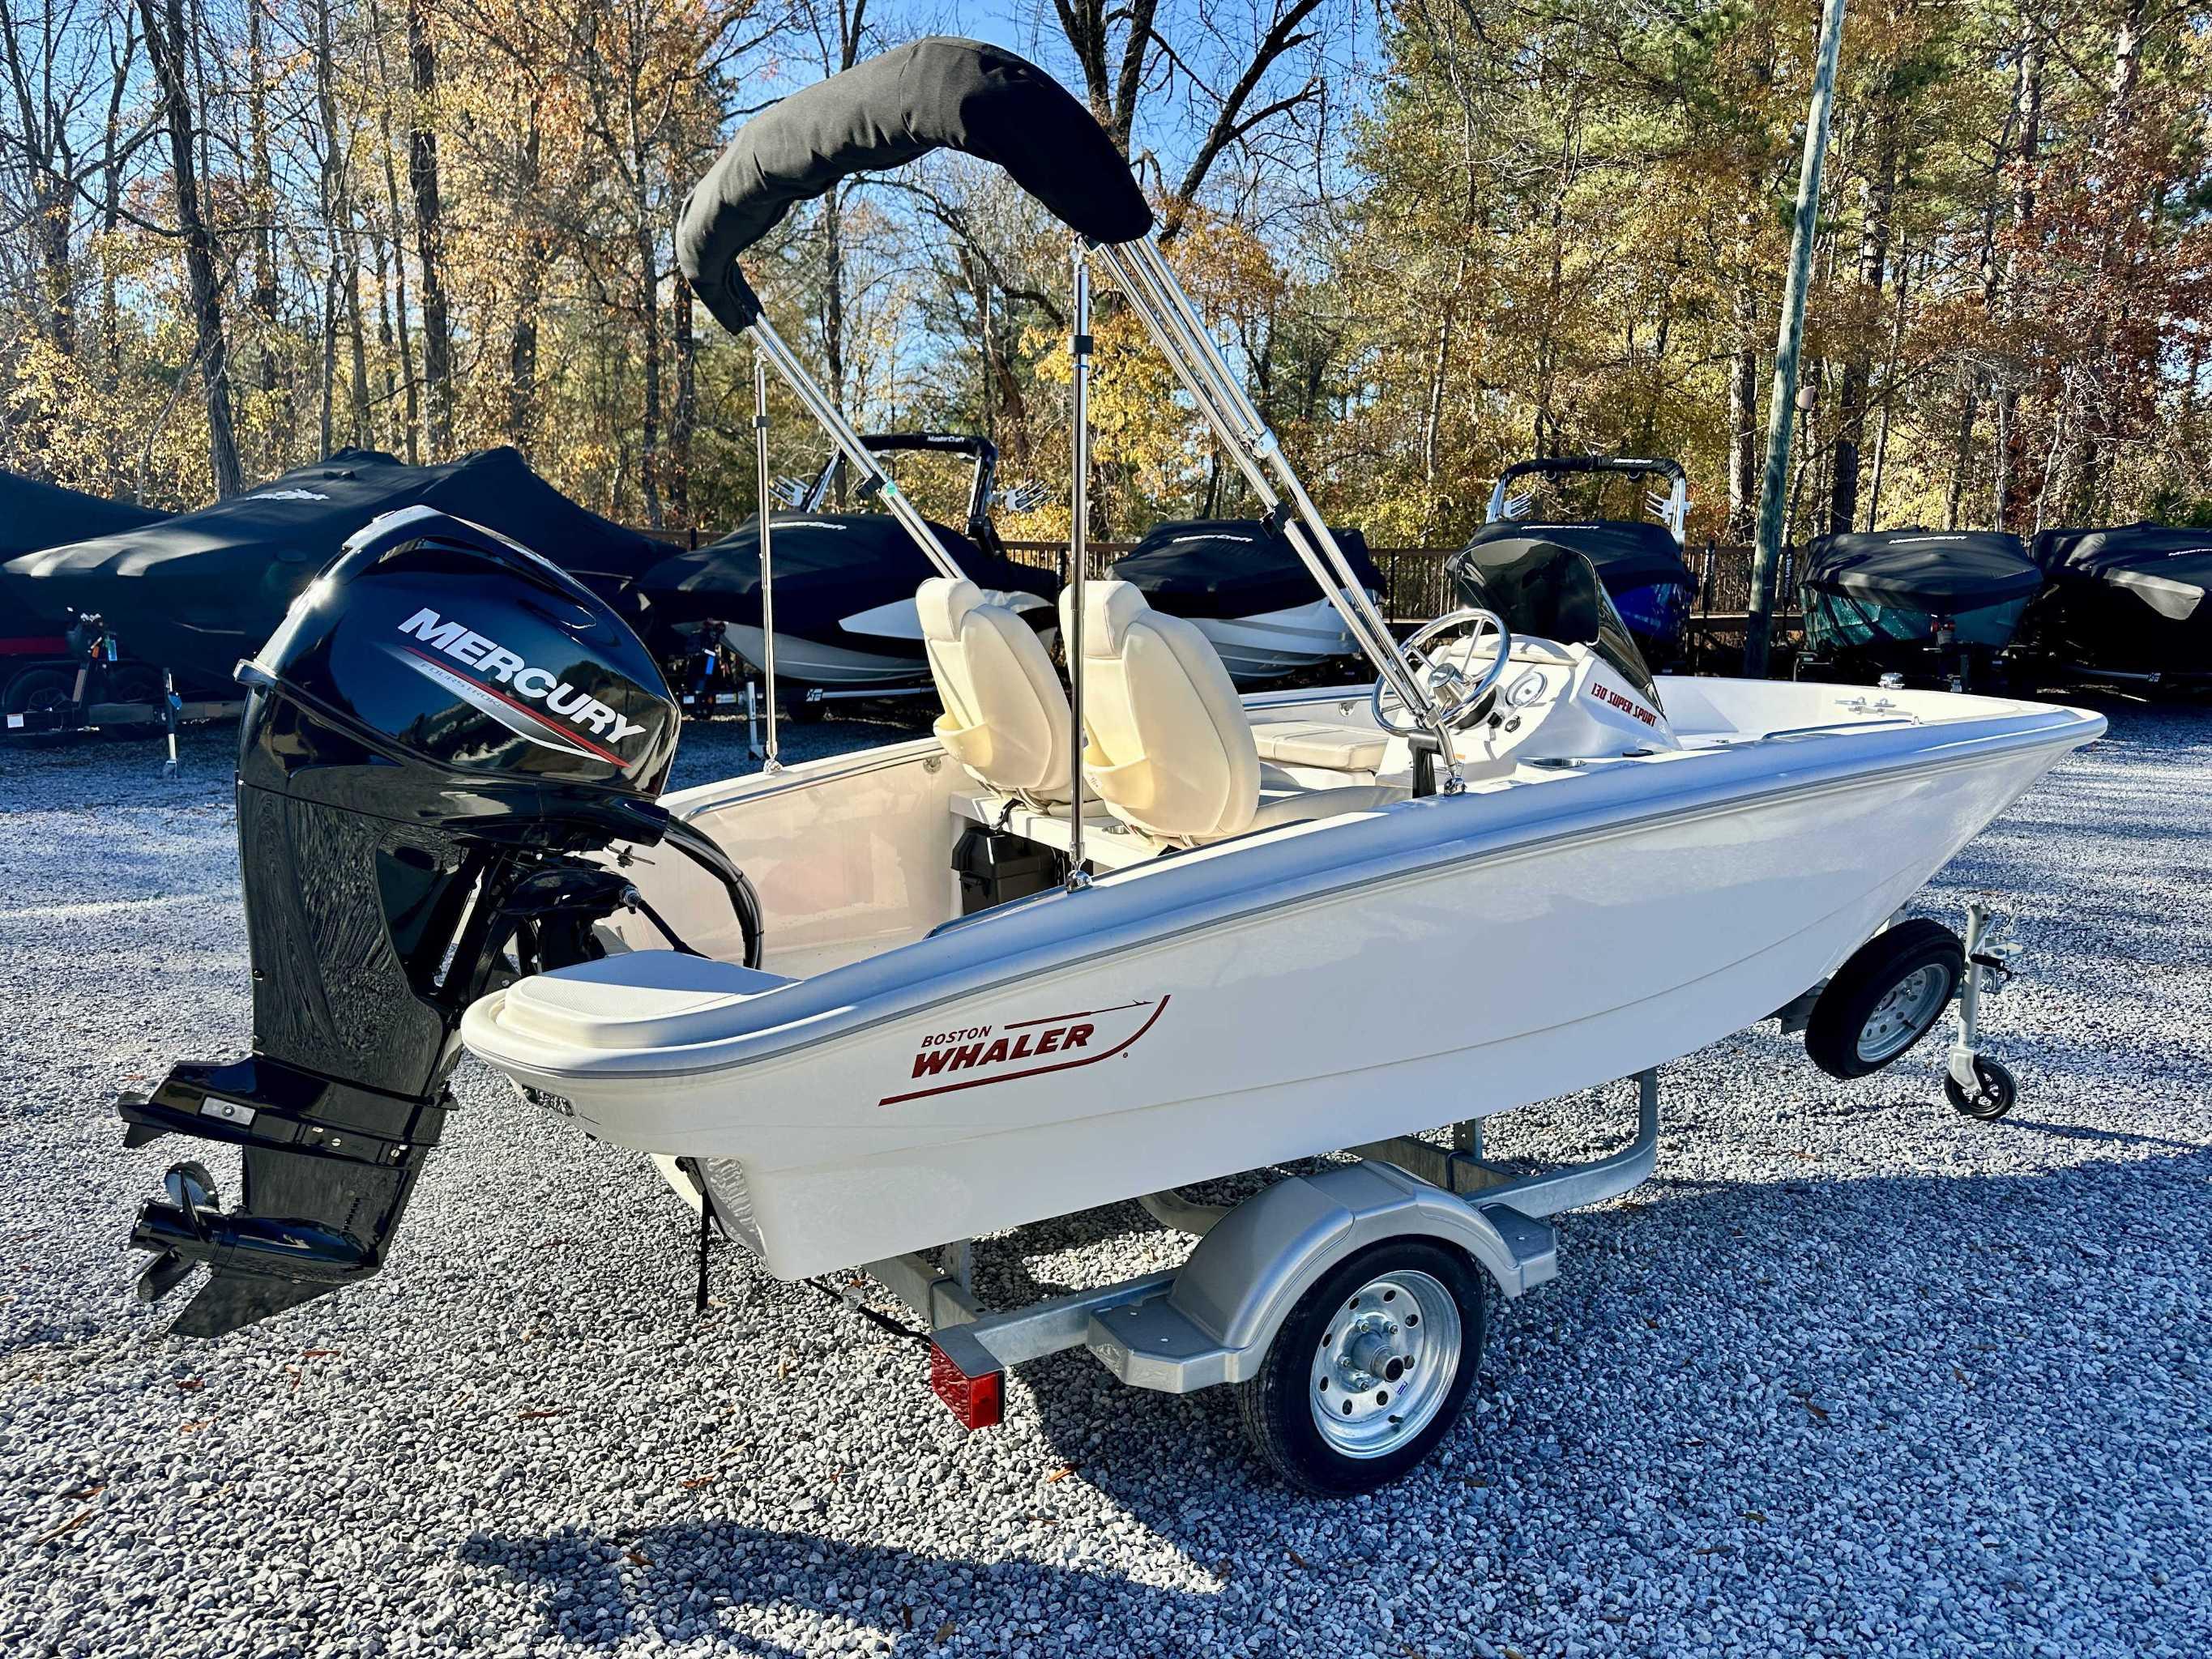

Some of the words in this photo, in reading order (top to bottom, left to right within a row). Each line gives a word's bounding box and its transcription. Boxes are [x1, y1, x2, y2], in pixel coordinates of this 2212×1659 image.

[398, 608, 647, 744] MERCURY
[421, 663, 506, 708] FOURSTROKE
[1591, 682, 1608, 701] 130
[1607, 691, 1633, 714] SUPER
[1632, 705, 1657, 727] SPORT
[911, 1023, 1095, 1079] WHALER
[920, 1025, 993, 1048] BOSTON
